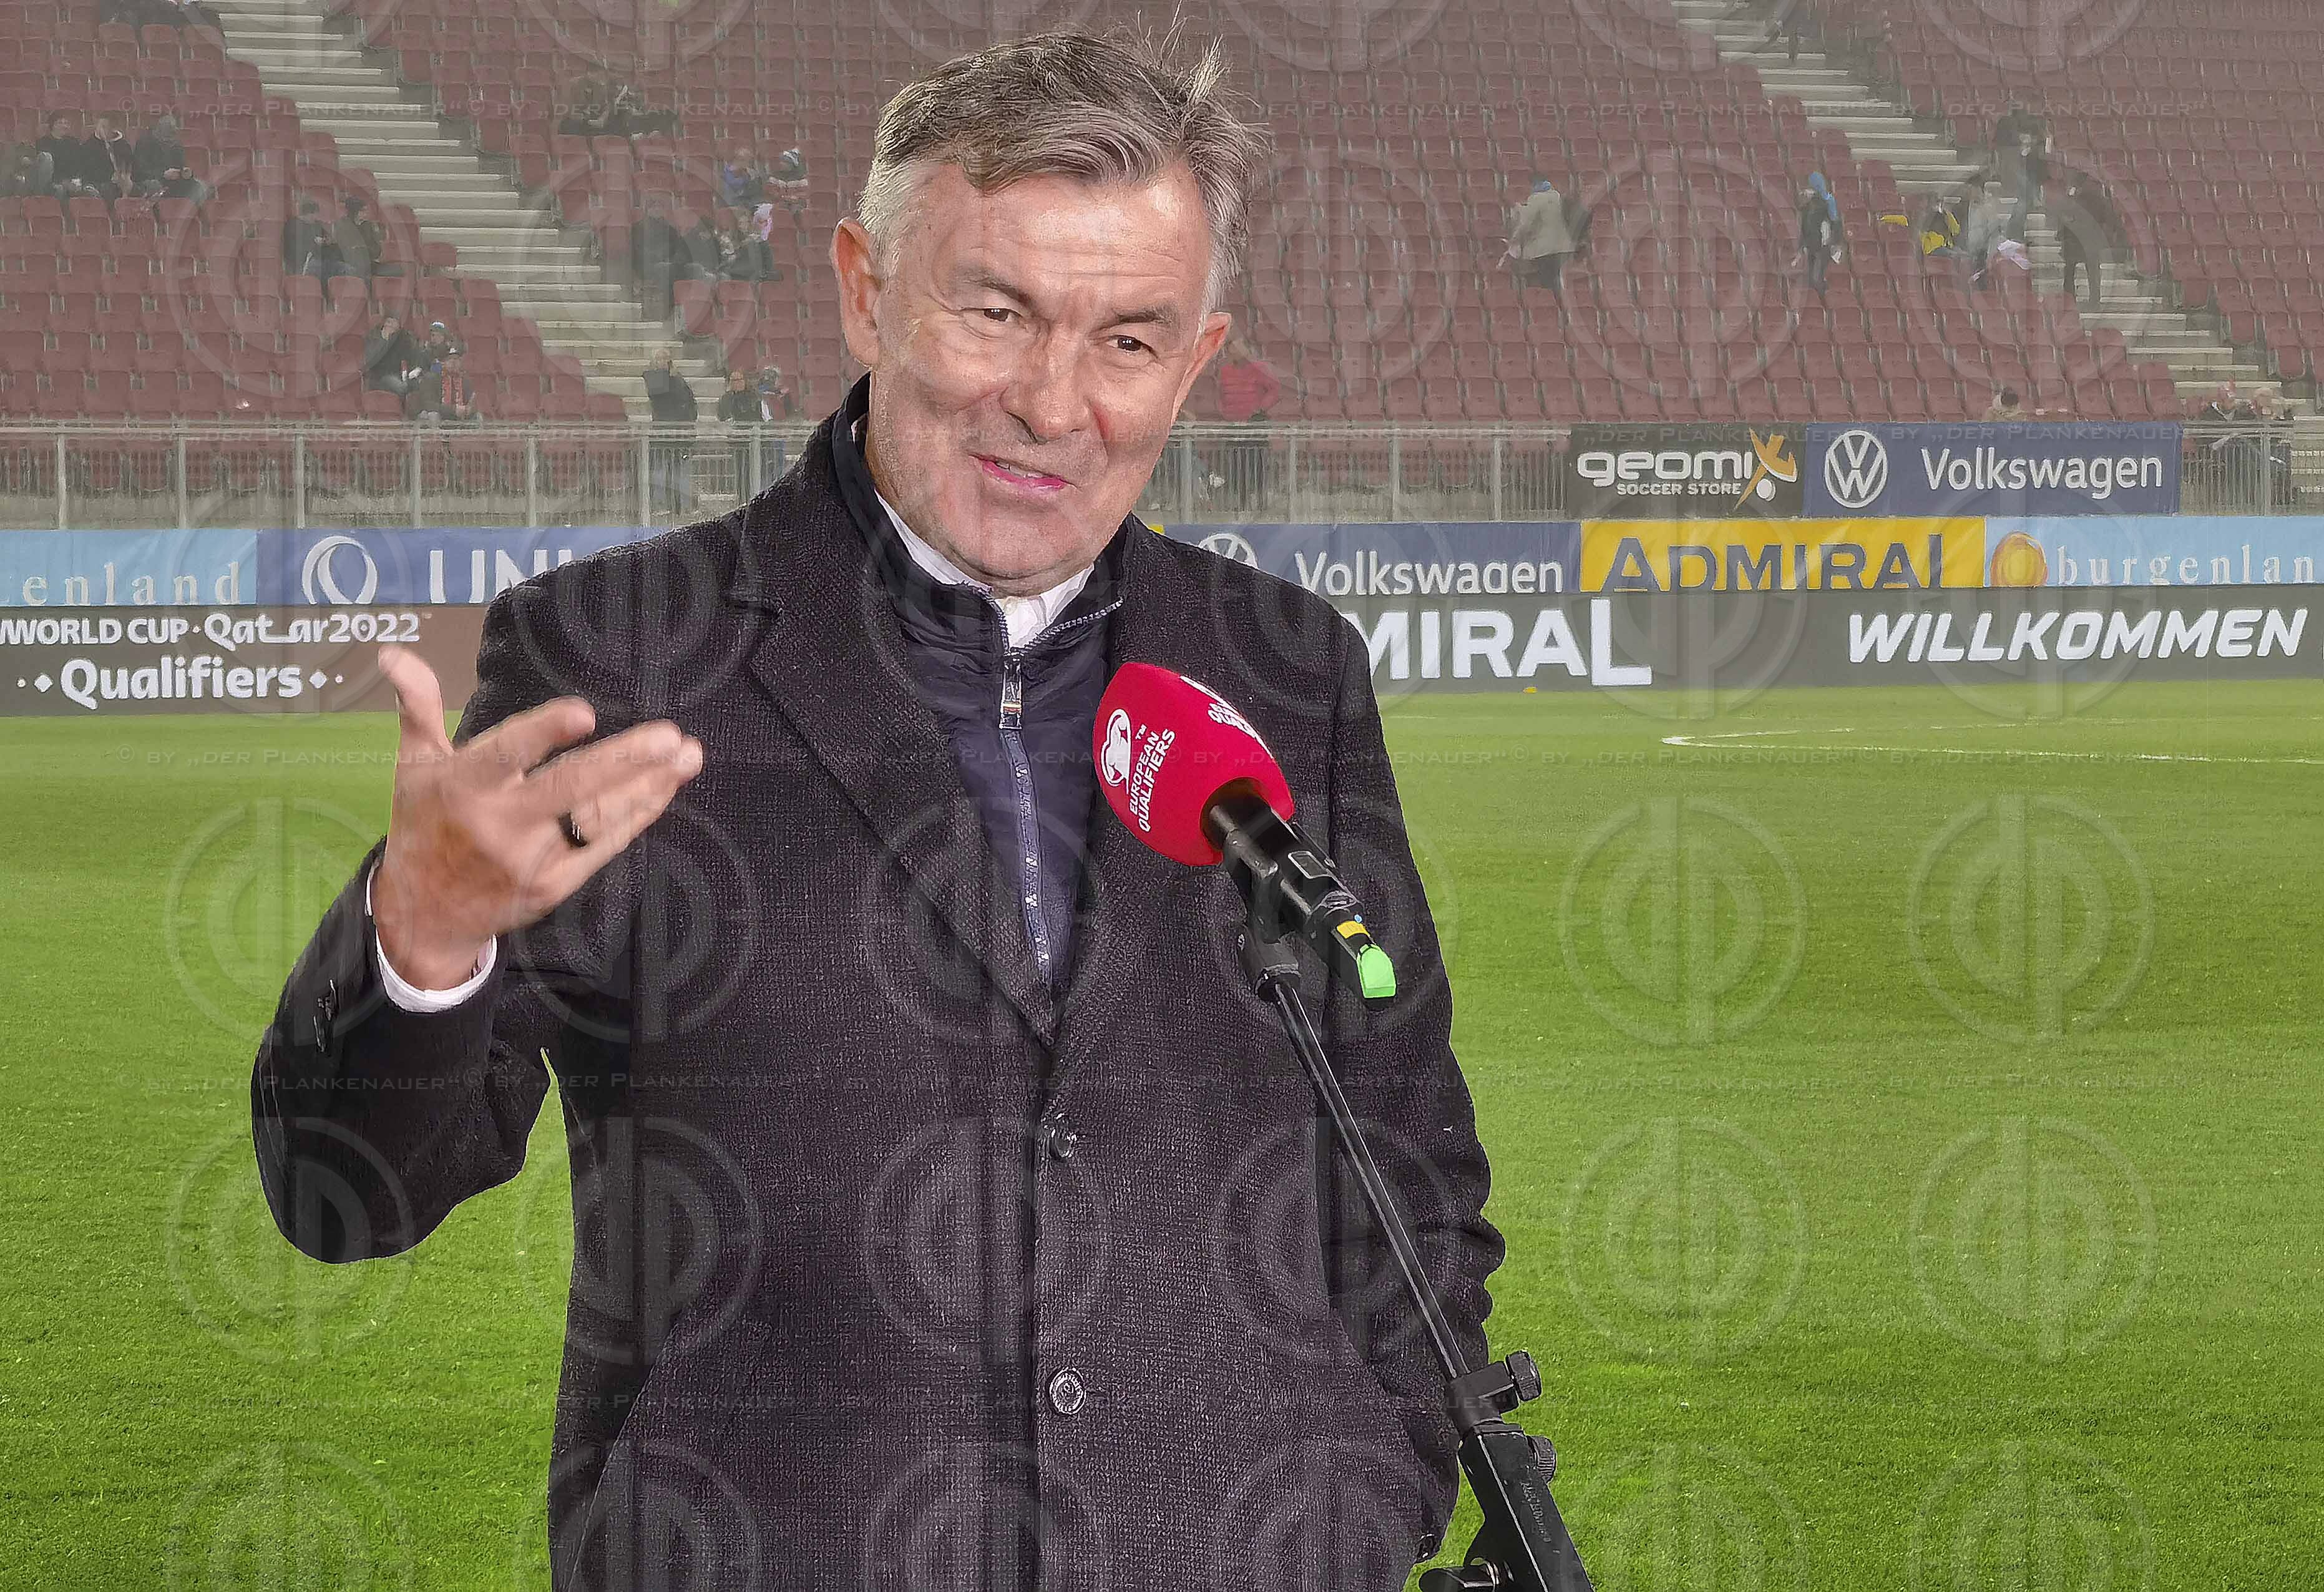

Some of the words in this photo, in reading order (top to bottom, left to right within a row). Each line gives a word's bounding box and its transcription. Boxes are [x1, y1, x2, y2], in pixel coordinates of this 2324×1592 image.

[1616, 482, 1682, 496] SOCCER
[1687, 481, 1742, 496] STORE
[1921, 446, 2163, 499] Volkswagen
[0, 561, 240, 605] enland
[1294, 549, 1563, 595] Volkswagen
[2057, 544, 2315, 585] burgenlan
[5, 618, 122, 645] WORLD
[127, 618, 188, 645] CUP
[1848, 607, 2308, 664] WILLKOMMEN
[61, 655, 303, 710] Qualifiers
[1129, 731, 1160, 816] EUROPEAN
[1138, 728, 1176, 833] QUALIFIERS
